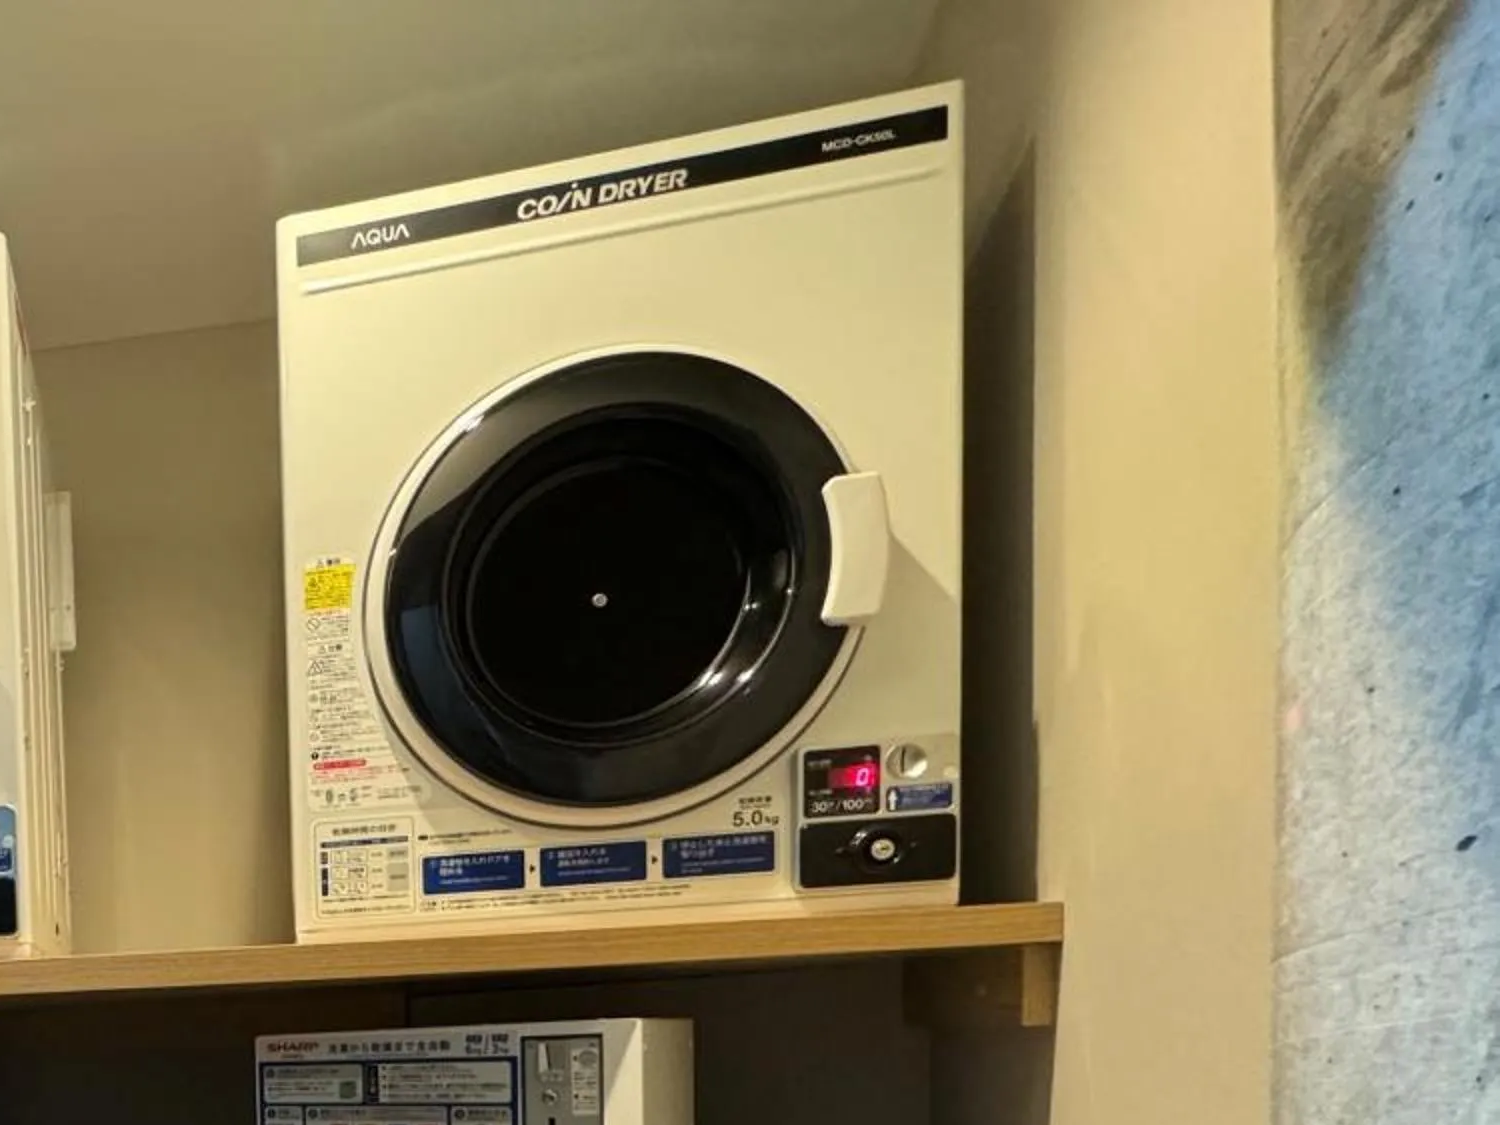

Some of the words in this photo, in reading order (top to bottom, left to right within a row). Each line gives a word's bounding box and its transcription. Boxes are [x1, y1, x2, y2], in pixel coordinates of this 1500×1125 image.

[516, 182, 592, 222] COIN
[597, 167, 689, 204] DRYER
[350, 224, 411, 250] AQUA
[854, 767, 870, 787] 0
[267, 1041, 320, 1053] SHARP
